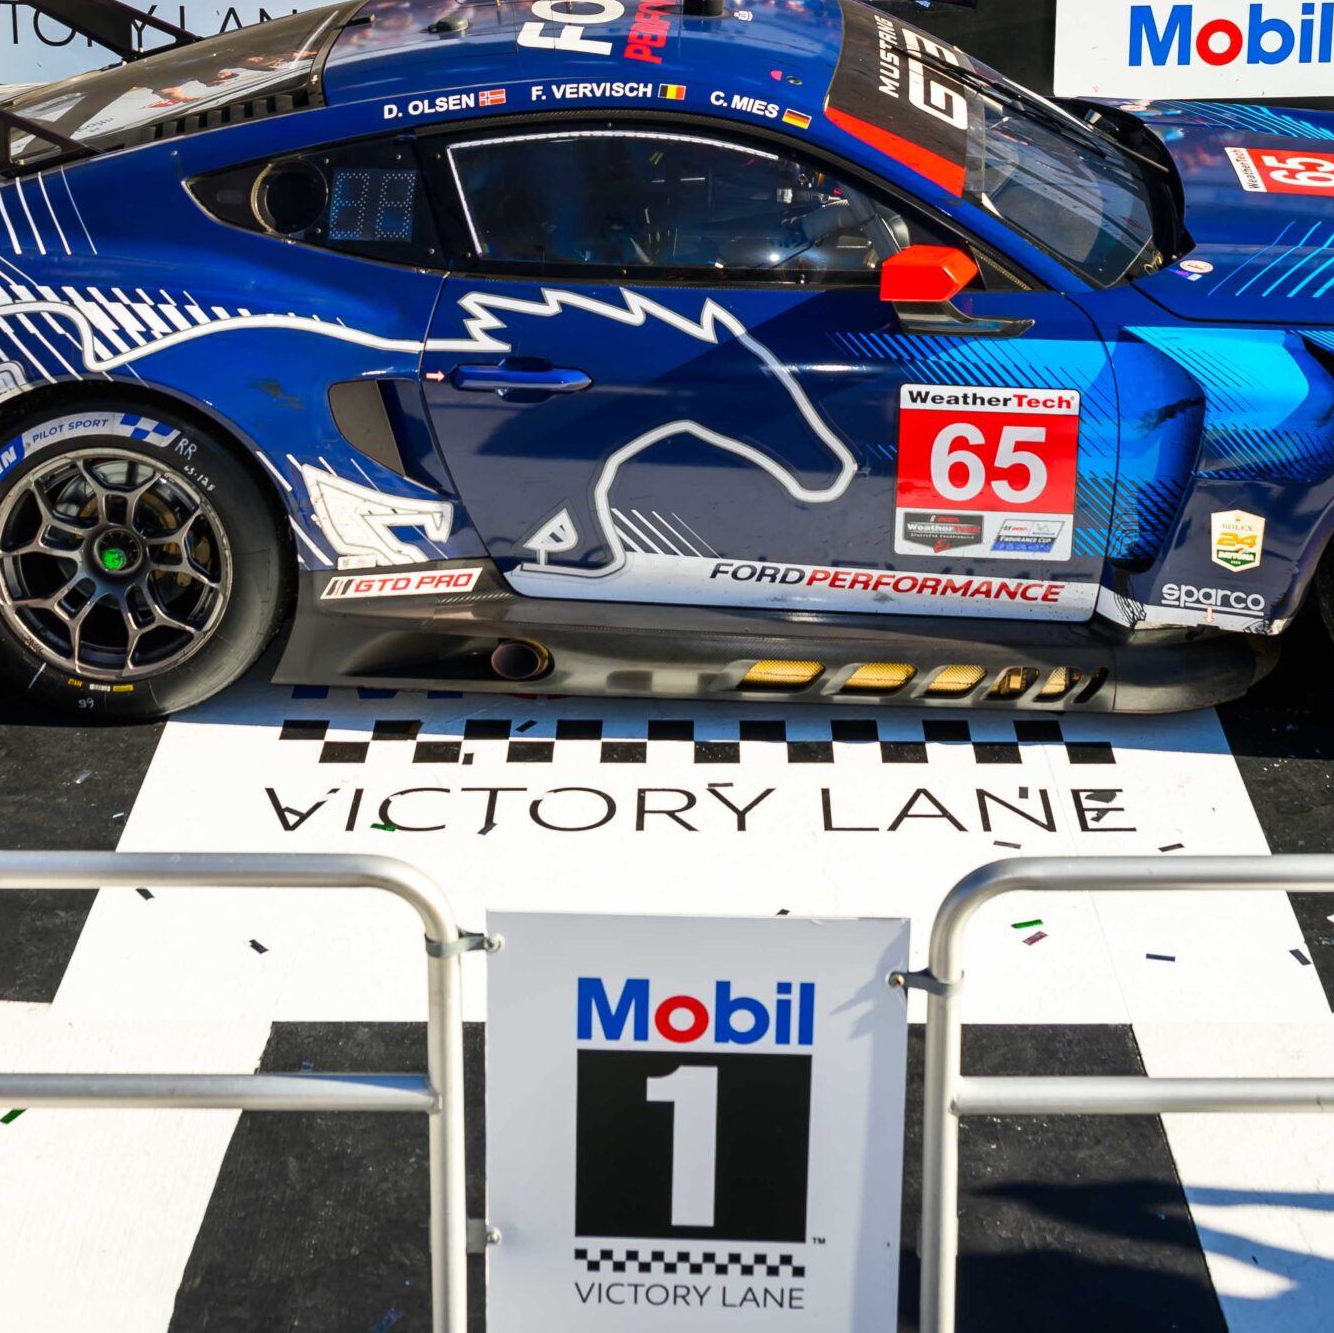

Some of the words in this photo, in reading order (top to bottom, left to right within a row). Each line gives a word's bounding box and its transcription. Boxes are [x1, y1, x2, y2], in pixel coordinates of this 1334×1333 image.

[1128, 1, 1334, 67] Mobil
[874, 15, 899, 98] MUSTANG
[532, 86, 546, 100] F.
[552, 83, 653, 100] VERVISCH
[384, 103, 403, 118] D.
[409, 93, 475, 116] OLSEN
[710, 91, 727, 106] C.
[732, 96, 779, 119] MIES
[908, 390, 1072, 410] WeatherTech
[32, 424, 64, 443] PILOT
[68, 419, 109, 431] SPORT
[175, 438, 197, 460] RR
[930, 422, 1048, 504] 65
[1217, 532, 1258, 548] 24
[1222, 524, 1253, 532] ROLEX
[1218, 552, 1254, 561] DAYTONA
[354, 574, 409, 596] GTD
[414, 571, 474, 592] PRO
[1162, 584, 1265, 611] sparco
[264, 787, 776, 834] VICTORY
[822, 786, 1137, 834] LANE
[577, 977, 816, 1046] Mobil
[646, 1065, 718, 1227] 1
[574, 1282, 711, 1307] VICTORY
[722, 1285, 805, 1310] LANE
